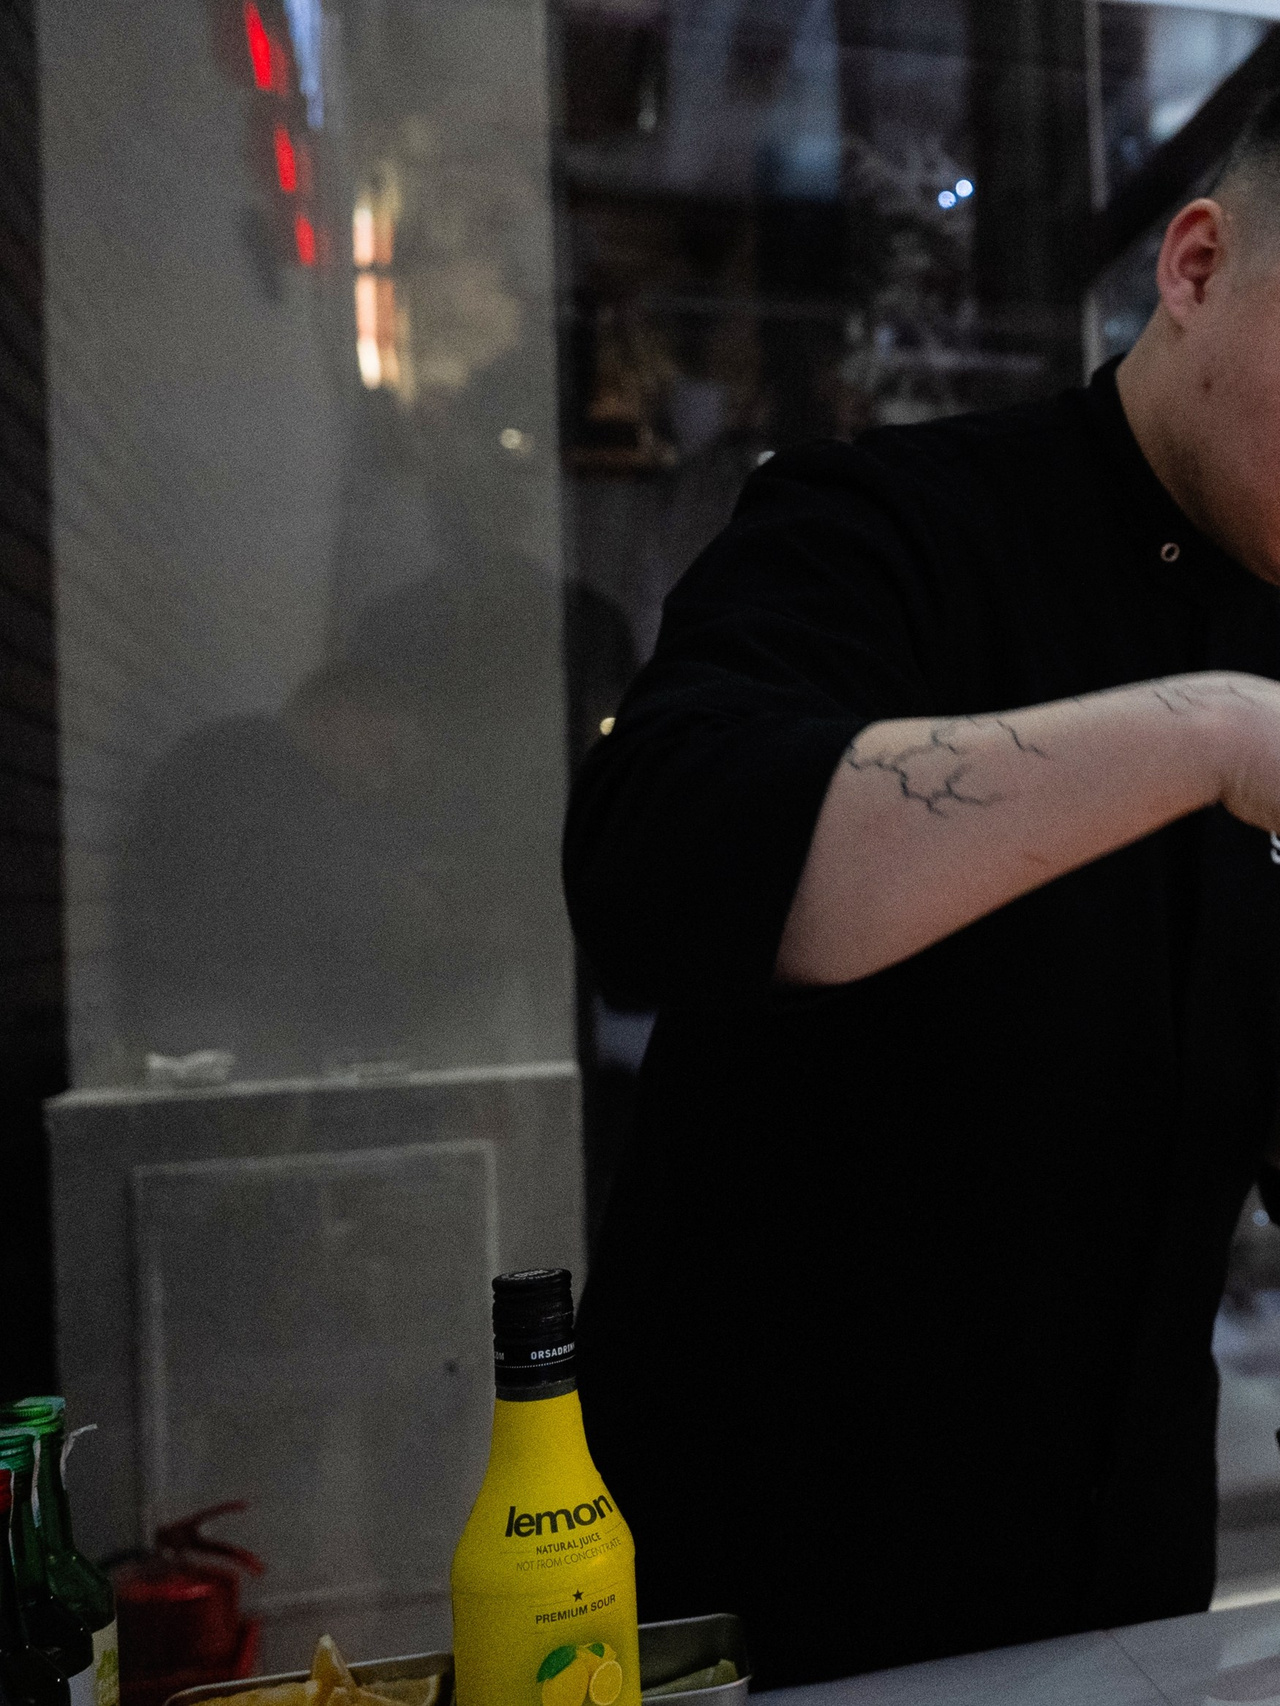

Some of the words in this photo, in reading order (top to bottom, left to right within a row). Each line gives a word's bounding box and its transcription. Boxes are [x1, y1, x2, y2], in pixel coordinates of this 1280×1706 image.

[504, 1494, 614, 1538] lemon
[516, 1560, 536, 1572] NOT
[536, 1557, 562, 1570] FROM
[564, 1536, 622, 1565] CONCENTRATE
[536, 1539, 579, 1555] NATURAL
[579, 1532, 602, 1549] JUICE
[535, 1605, 588, 1625] PREMIUM
[590, 1594, 616, 1612] SOUR
